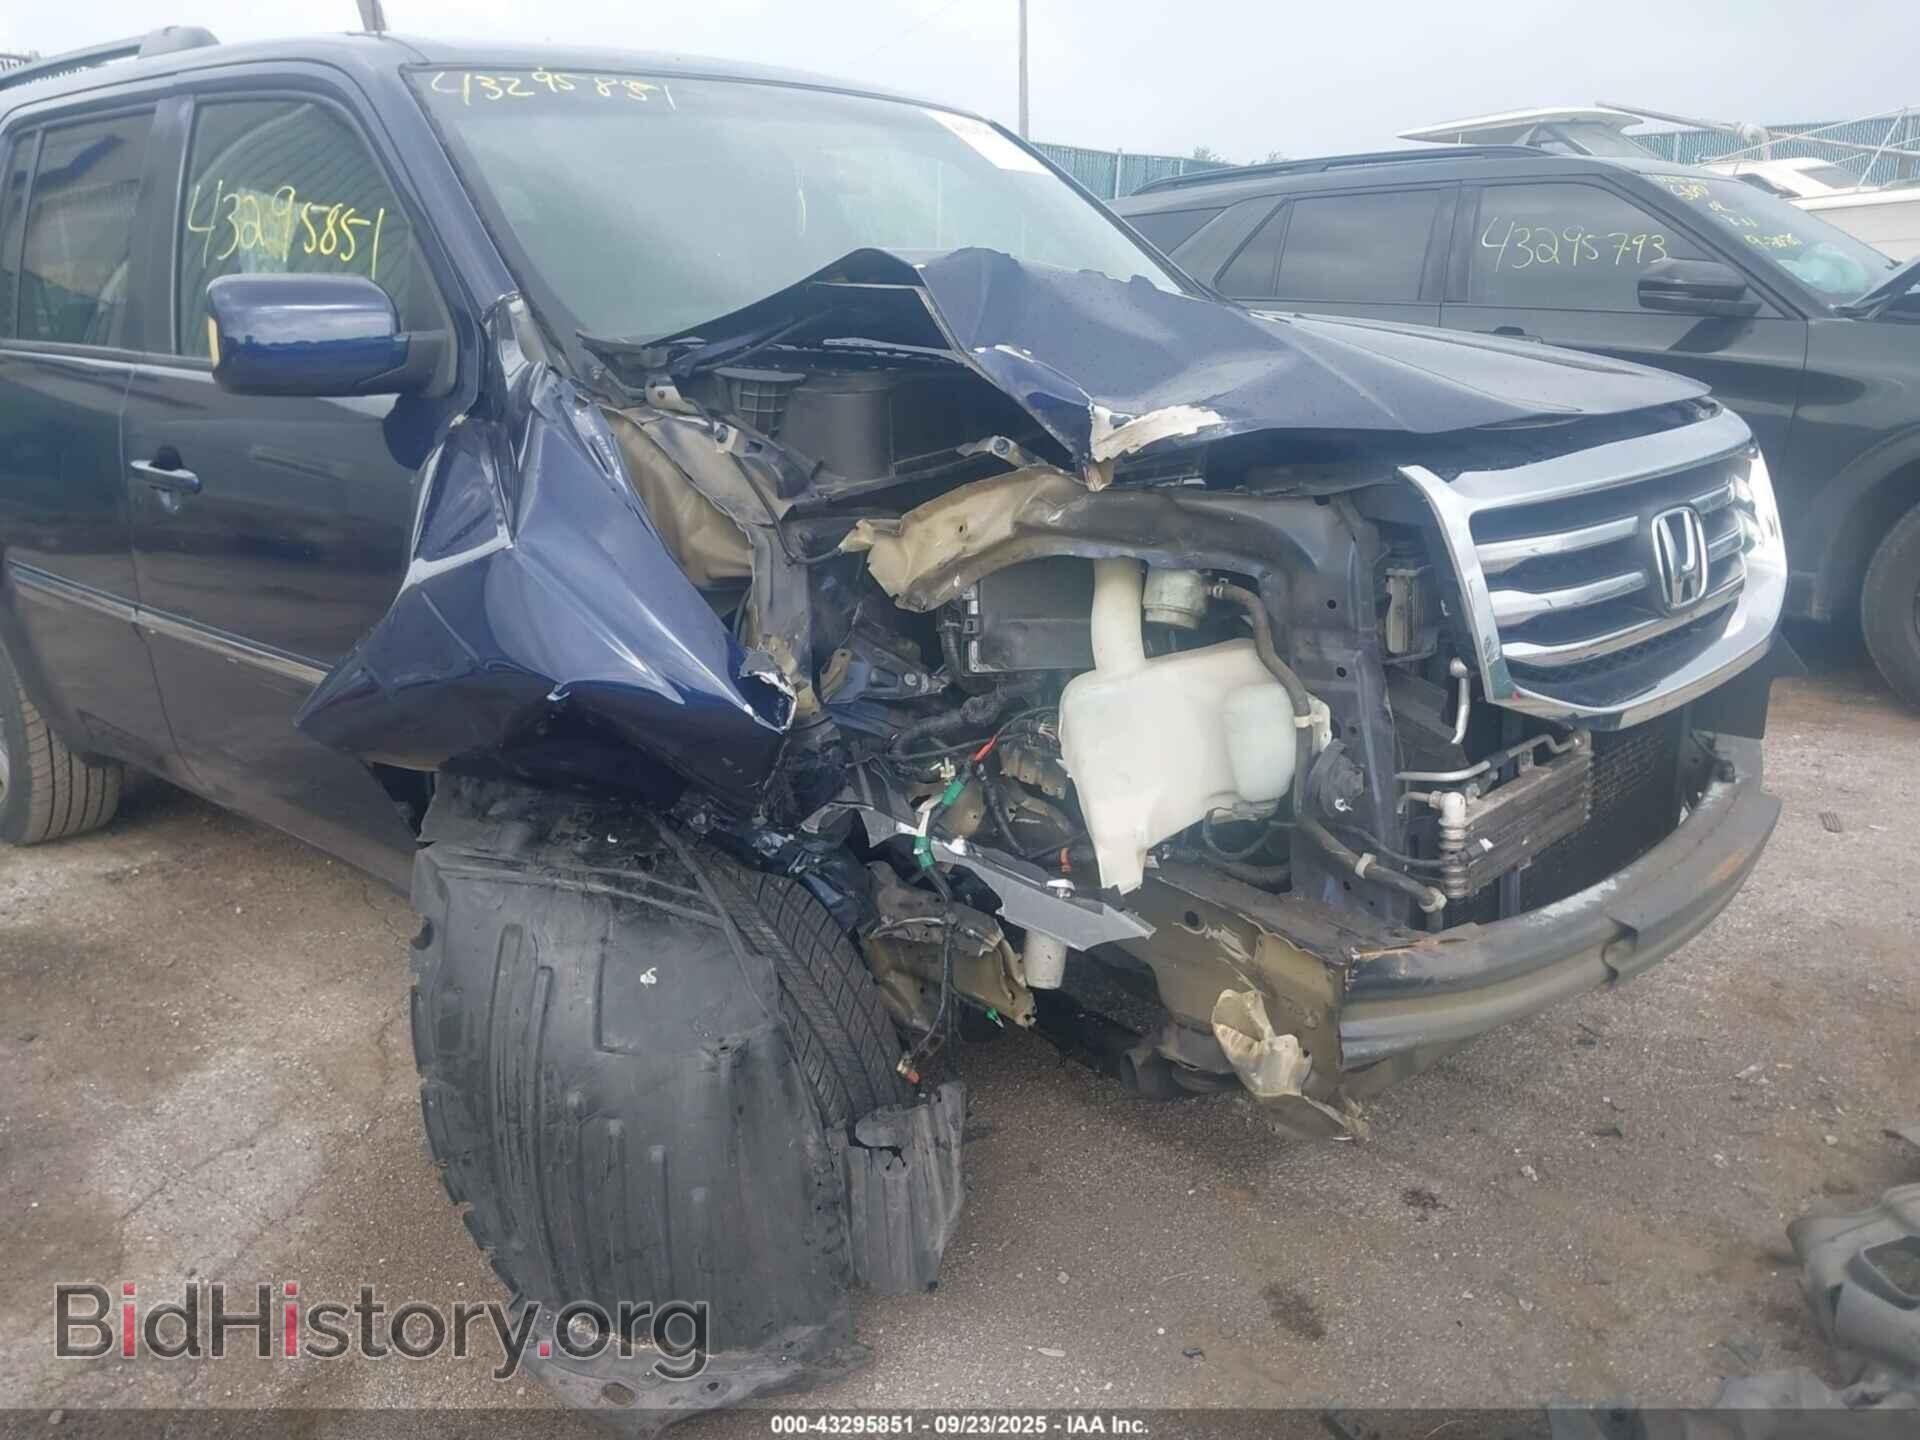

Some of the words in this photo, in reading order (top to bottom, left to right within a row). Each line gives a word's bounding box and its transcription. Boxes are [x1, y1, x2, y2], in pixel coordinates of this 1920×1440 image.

[432, 68, 677, 110] 43295851
[187, 179, 386, 280] 43295851
[1481, 217, 1671, 272] 43295793
